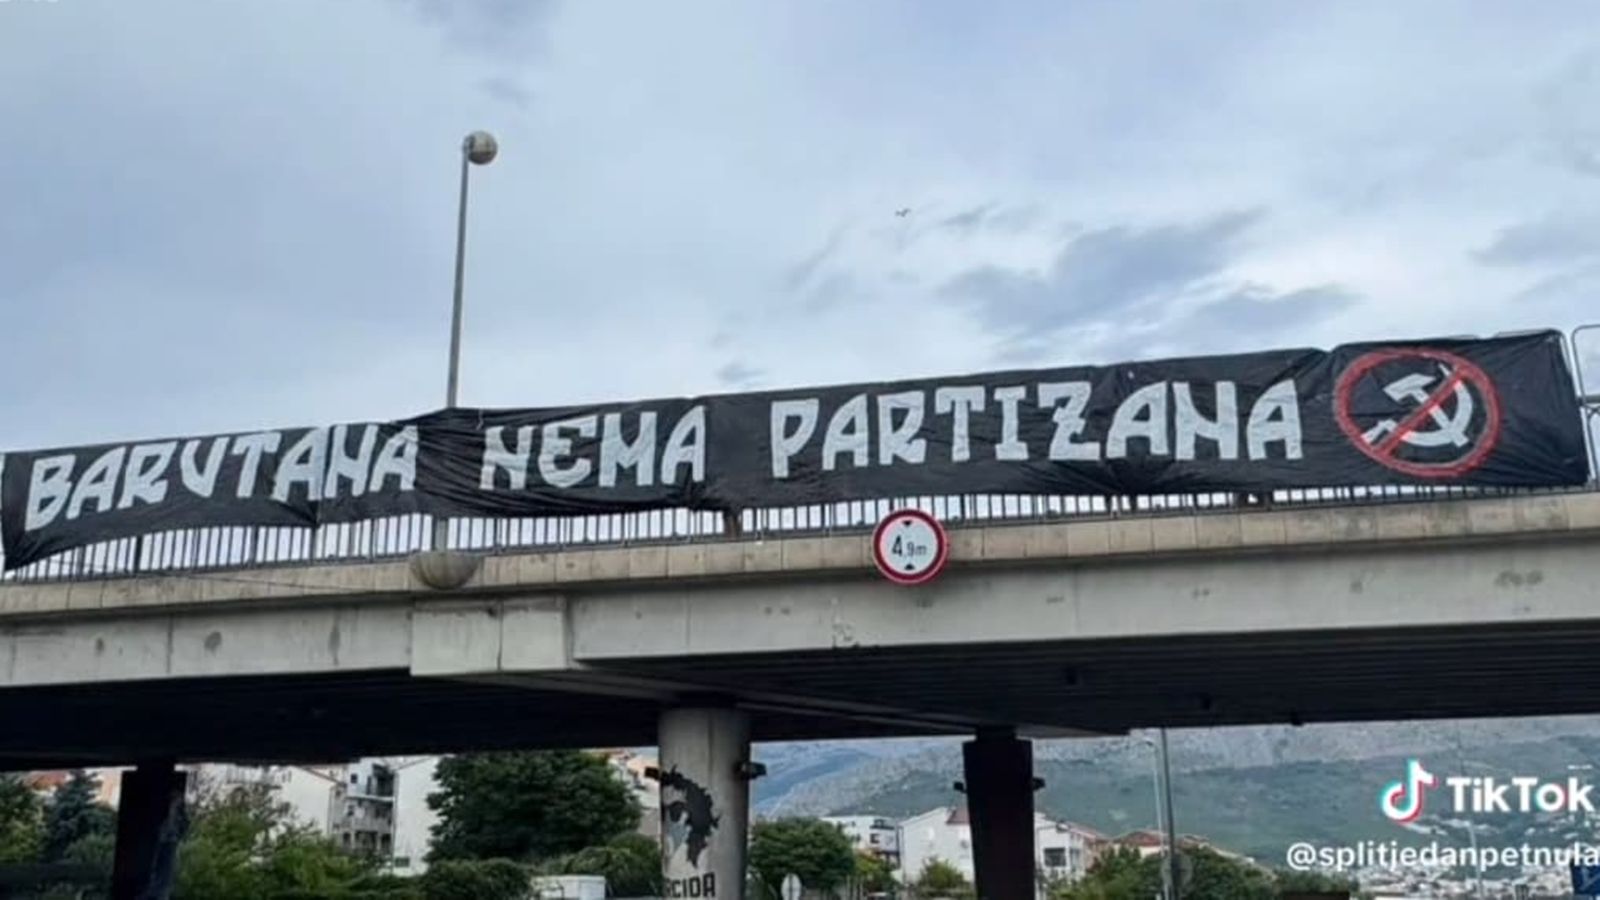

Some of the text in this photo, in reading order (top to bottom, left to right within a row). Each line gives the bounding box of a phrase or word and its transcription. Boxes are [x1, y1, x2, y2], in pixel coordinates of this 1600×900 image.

[25, 380, 1303, 531] BARUTANA NEMA PARTIZANA
